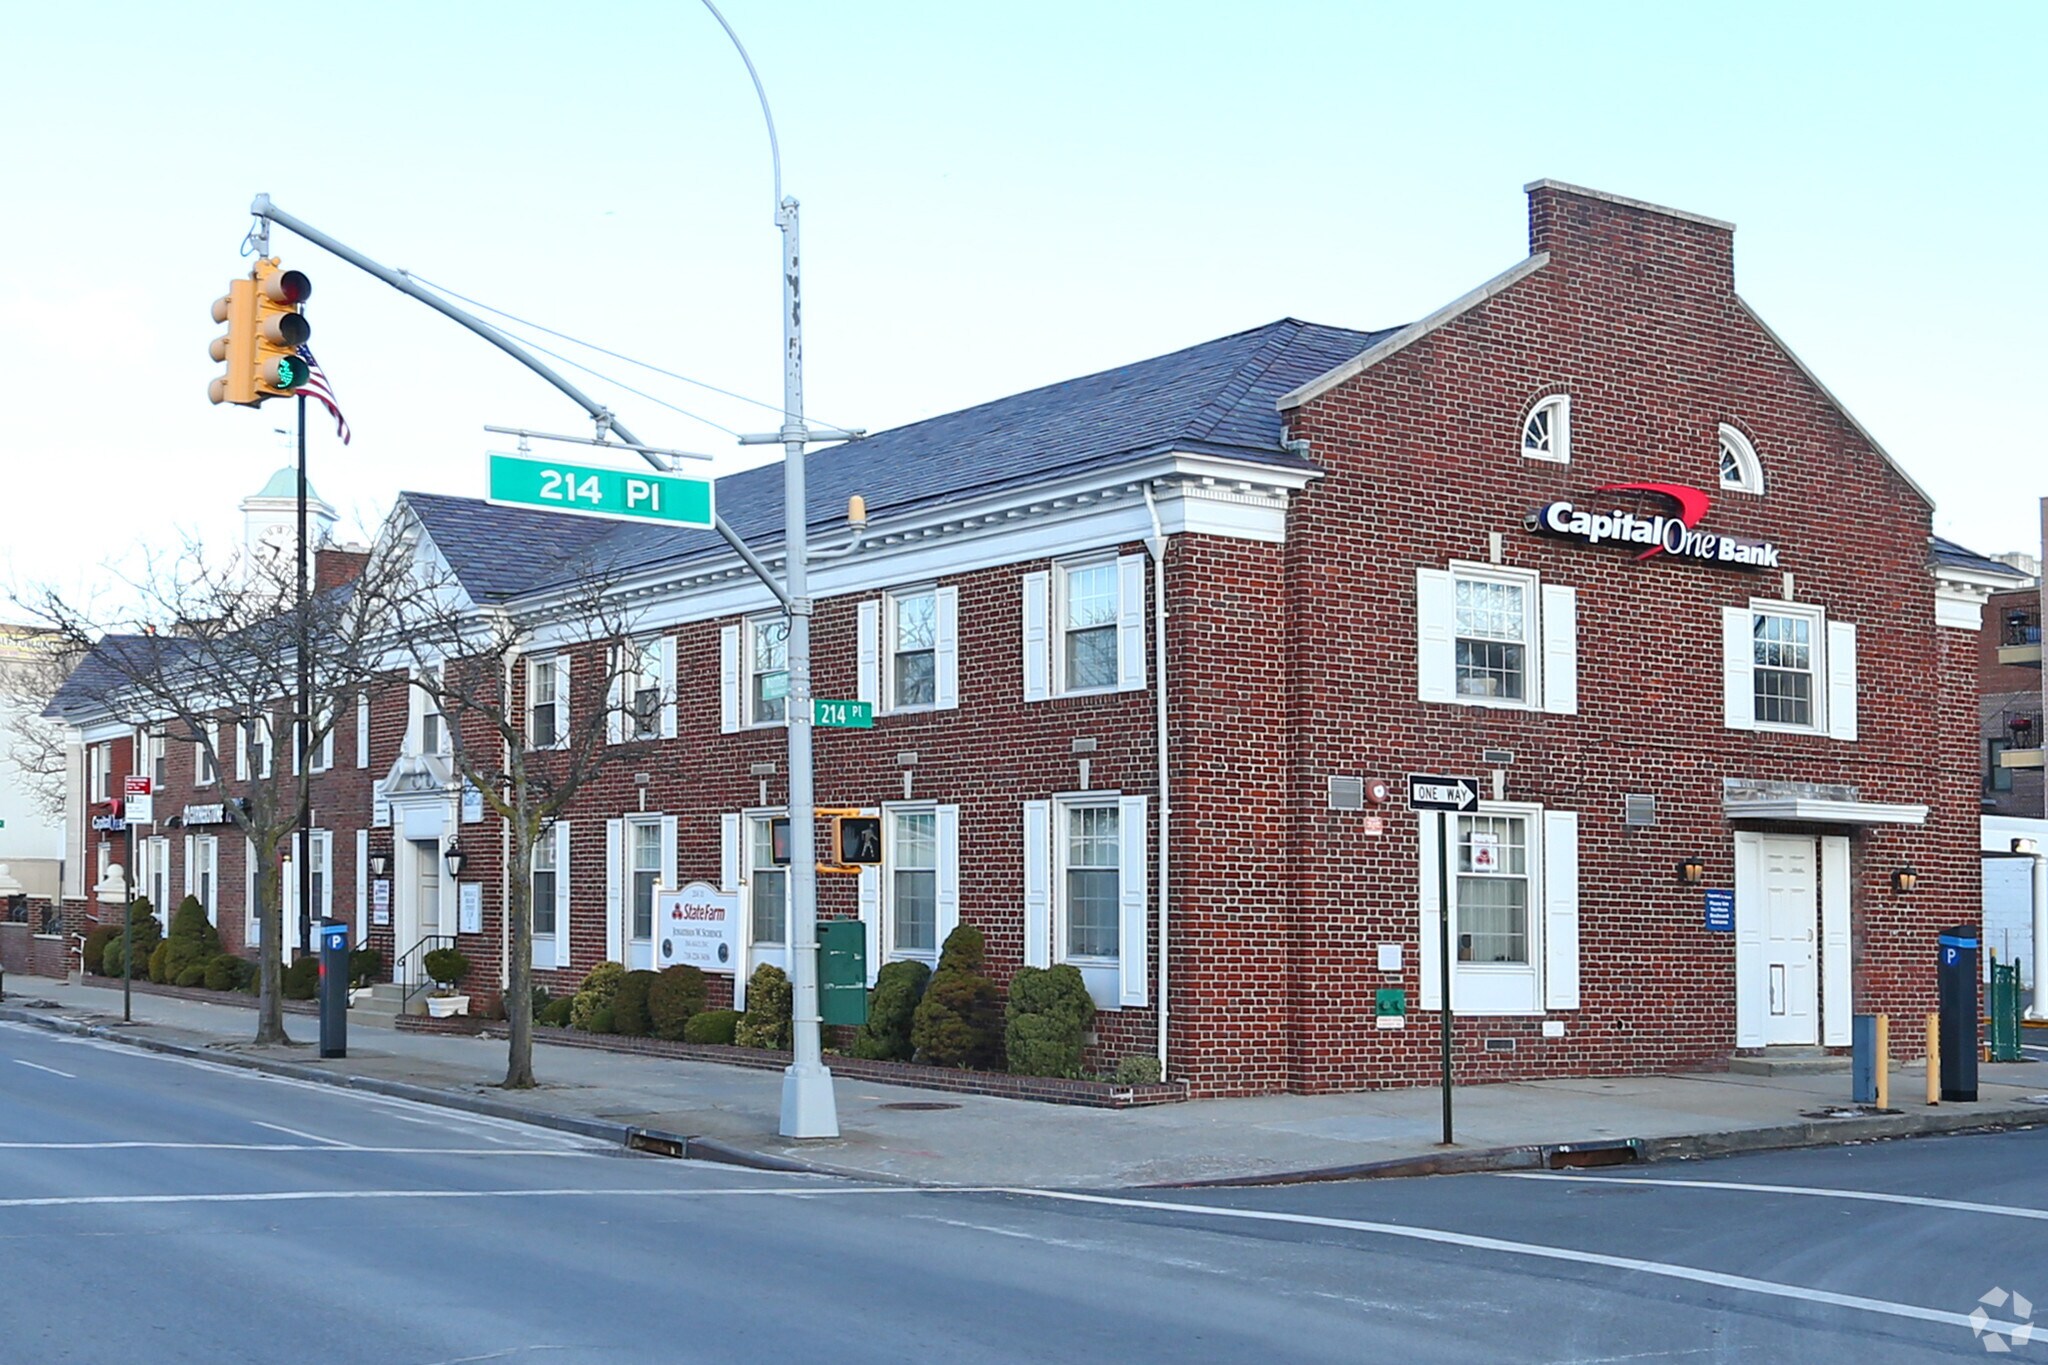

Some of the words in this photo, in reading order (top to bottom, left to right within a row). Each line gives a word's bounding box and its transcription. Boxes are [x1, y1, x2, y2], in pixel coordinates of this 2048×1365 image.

[539, 469, 603, 505] 214
[1718, 537, 1779, 568] Bank
[821, 703, 846, 724] 214
[1418, 785, 1438, 800] ONE
[1446, 788, 1468, 802] WAY
[332, 934, 342, 949] P
[1946, 948, 1956, 964] P
